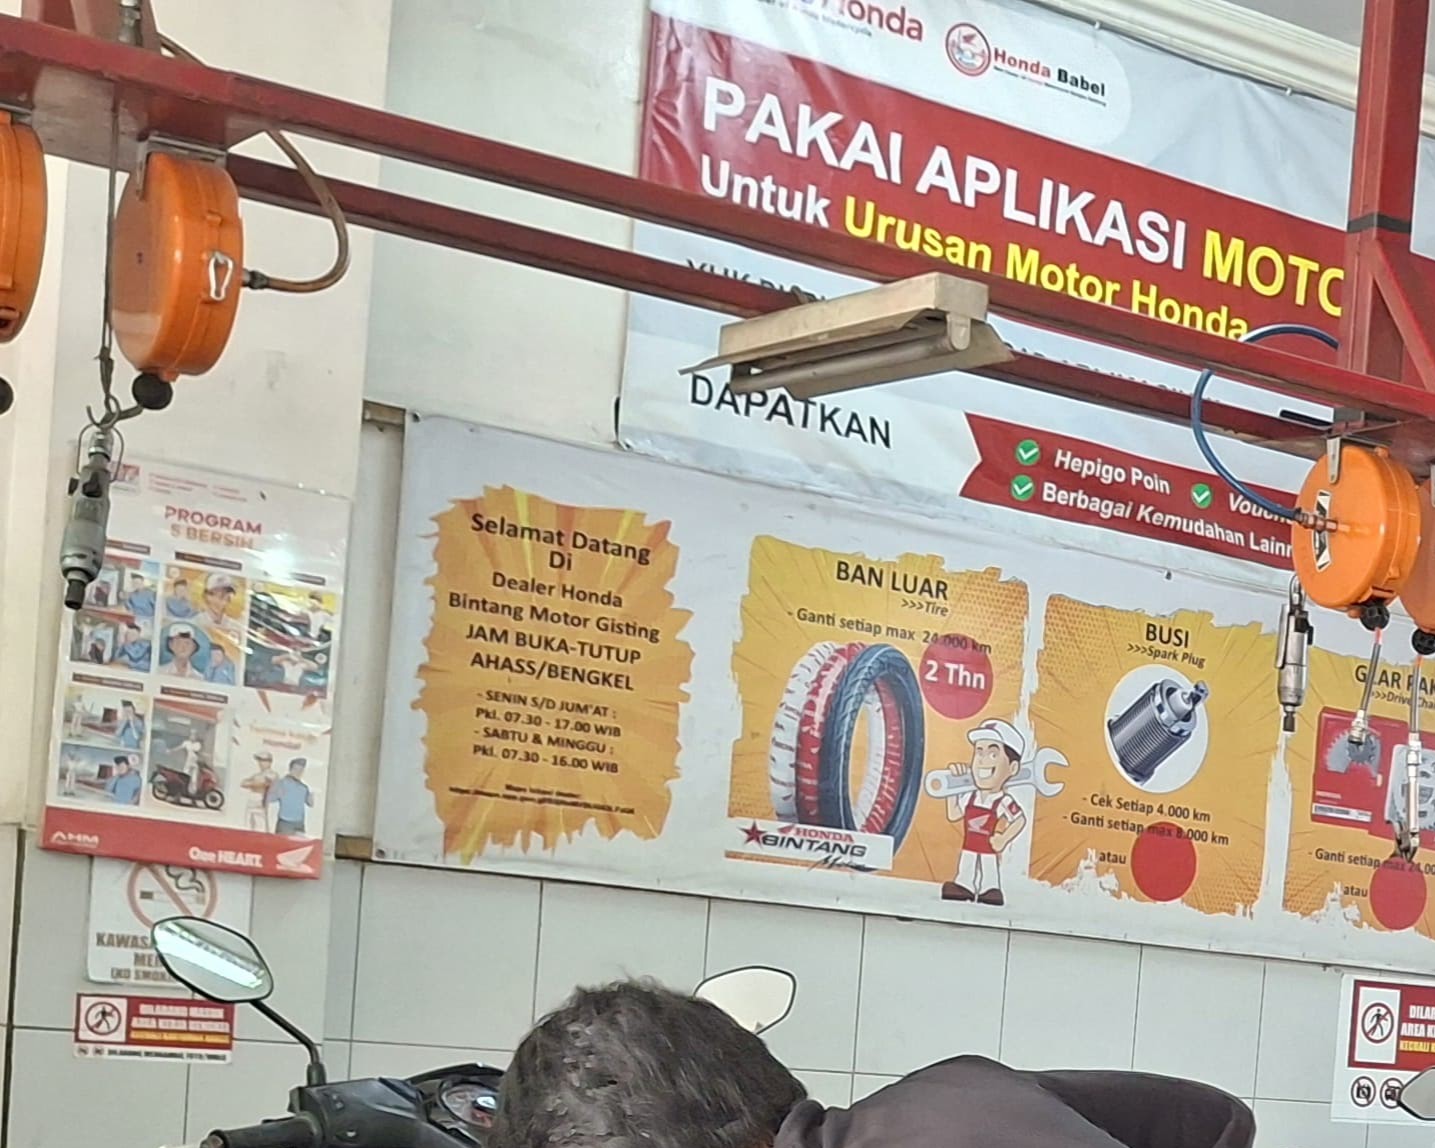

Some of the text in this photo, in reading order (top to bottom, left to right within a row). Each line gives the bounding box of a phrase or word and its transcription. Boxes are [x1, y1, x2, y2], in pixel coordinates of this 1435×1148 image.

[836, 0, 923, 41] onda
[993, 47, 1051, 79] Honda
[1057, 68, 1106, 97] Babel
[703, 76, 1344, 318] PAKAI APLIKASI MOTO
[700, 155, 1249, 342] Untuk Urusan Motor Honda
[690, 372, 891, 449] DAPATKAN
[1055, 449, 1170, 496] Hepigo Poin
[163, 505, 263, 535] PROGRAM
[1043, 481, 1132, 520] Berbagai
[1136, 502, 1244, 546] Kemudahan
[471, 513, 651, 565] Selamat Datang
[549, 552, 572, 571] Di
[492, 572, 623, 608] Dealer Honda
[836, 560, 948, 600] BAN LUAR
[449, 592, 660, 643] Bintang Motor Gisting
[797, 608, 836, 628] Ganti
[839, 614, 882, 637] setiap
[886, 626, 915, 641] max
[971, 639, 992, 655] km
[466, 624, 641, 665] JAM BUKA-TUTUP
[1145, 623, 1190, 649] BUSI
[470, 652, 634, 691] AHASS/BENGKEL
[924, 660, 985, 690] 2 Thn
[1182, 650, 1206, 670] Plug
[1355, 665, 1401, 691] GAR
[486, 689, 527, 707] SENIN
[531, 694, 556, 711] S/D
[504, 710, 542, 727] 07.30
[554, 717, 591, 733] 17.00
[594, 721, 621, 737] WIB
[483, 726, 528, 744] SABTU
[546, 734, 606, 754] MINGGU
[502, 747, 540, 764] 07.30
[551, 754, 589, 770] 16.00
[592, 758, 619, 774] WIB
[1090, 793, 1211, 823] Cek Setiap 4.000 km
[795, 828, 856, 843] HONDA
[1070, 812, 1105, 828] Ganti
[1108, 816, 1144, 835] setiap
[1211, 831, 1230, 846] km
[761, 834, 868, 858] BINTANG
[1099, 850, 1127, 865] atau
[1315, 848, 1345, 863] Ganti
[1347, 853, 1380, 871] setiap
[1343, 882, 1368, 898] atau
[96, 932, 154, 949] KAWAS
[1400, 1022, 1425, 1037] AREA
